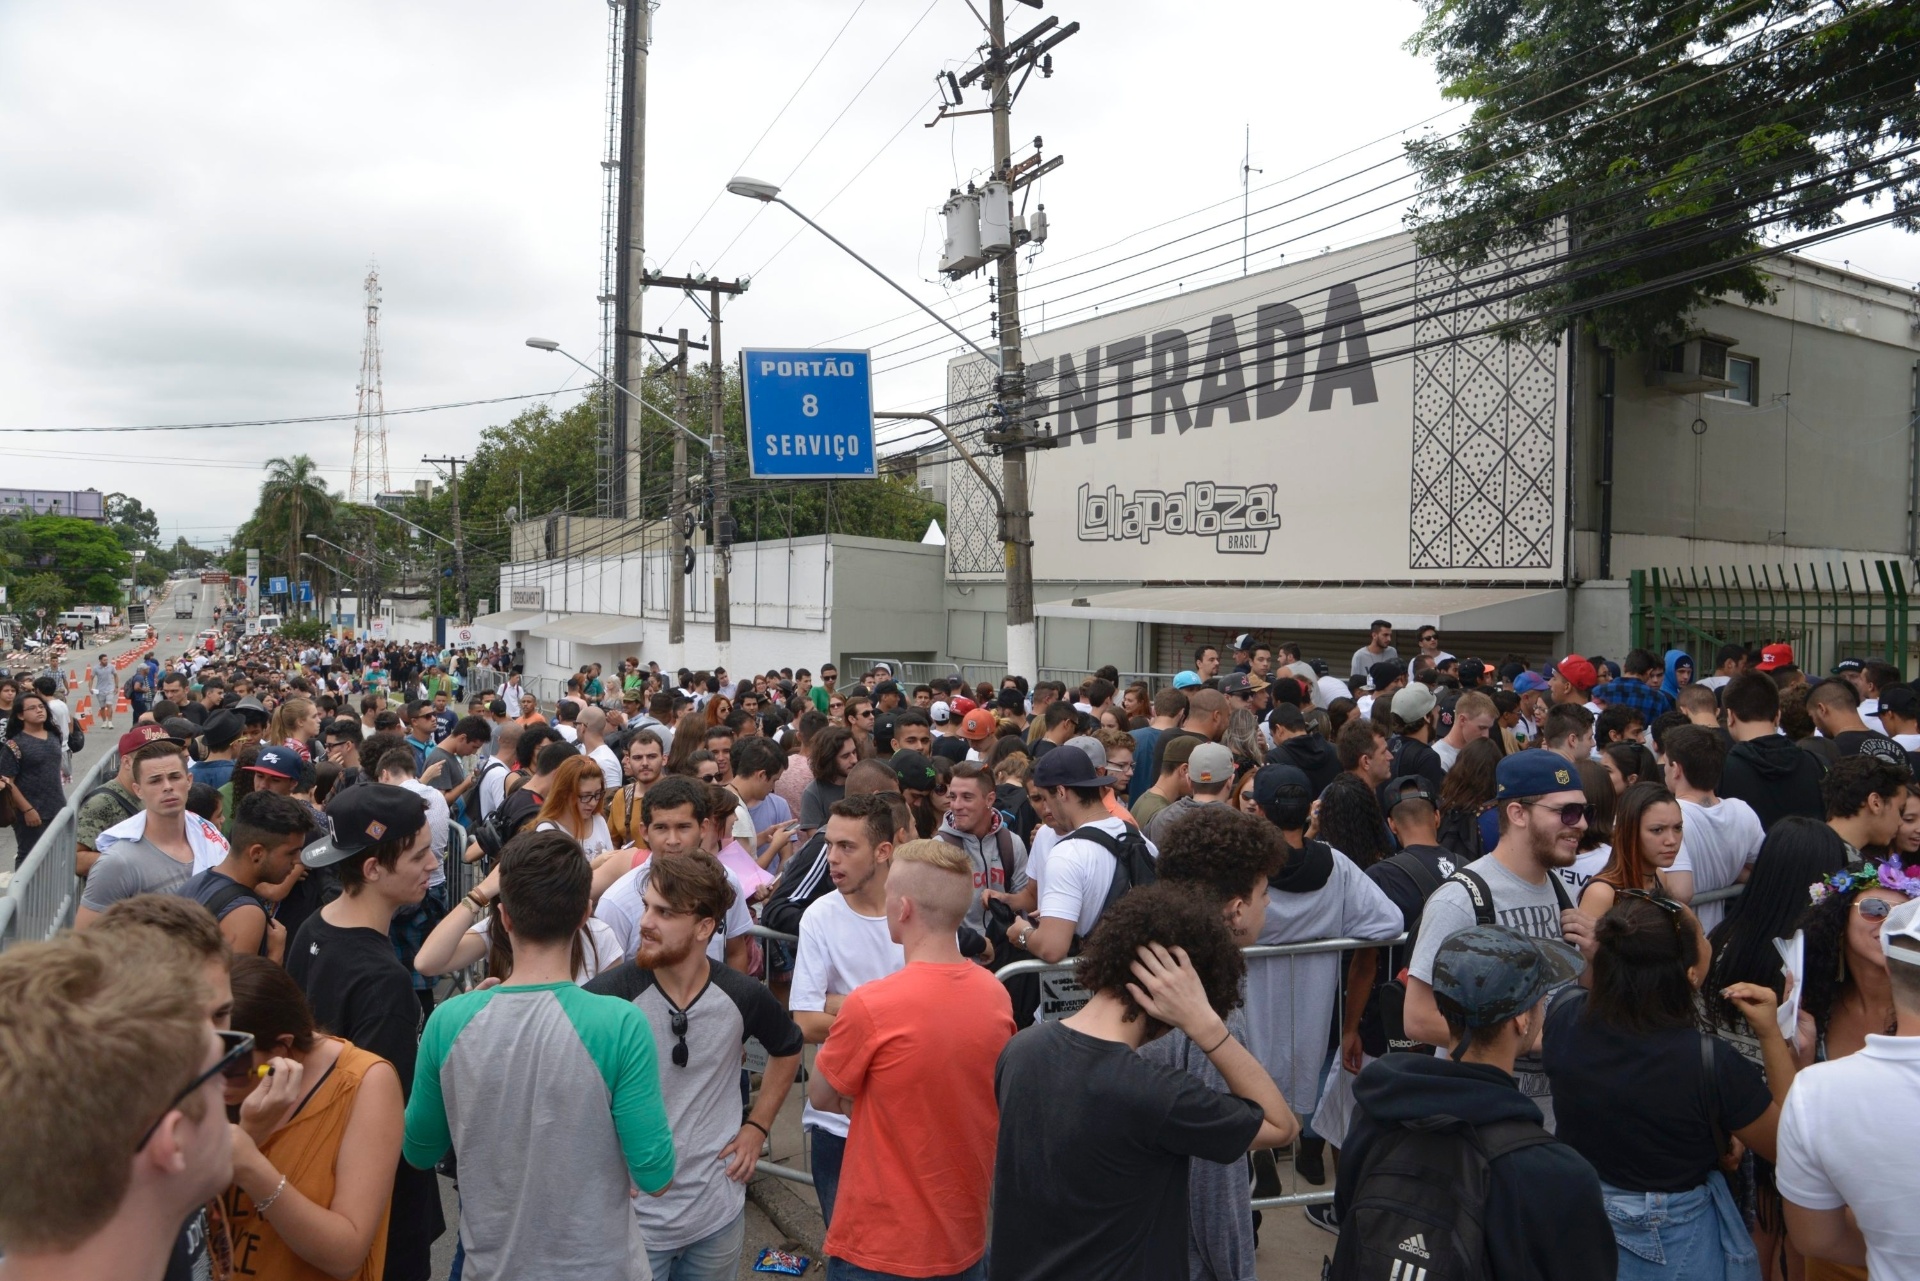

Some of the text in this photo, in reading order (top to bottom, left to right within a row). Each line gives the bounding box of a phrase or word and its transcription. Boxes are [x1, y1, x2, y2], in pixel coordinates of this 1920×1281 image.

[761, 358, 854, 376] PORTÃO
[1024, 283, 1379, 453] ENTRADA
[802, 394, 819, 417] 8
[766, 434, 859, 462] SERVIÇO
[1228, 534, 1257, 549] BRASIL
[248, 575, 257, 586] 7
[300, 587, 306, 600] 7
[973, 867, 1005, 888] COST
[1398, 1242, 1430, 1259] adidas
